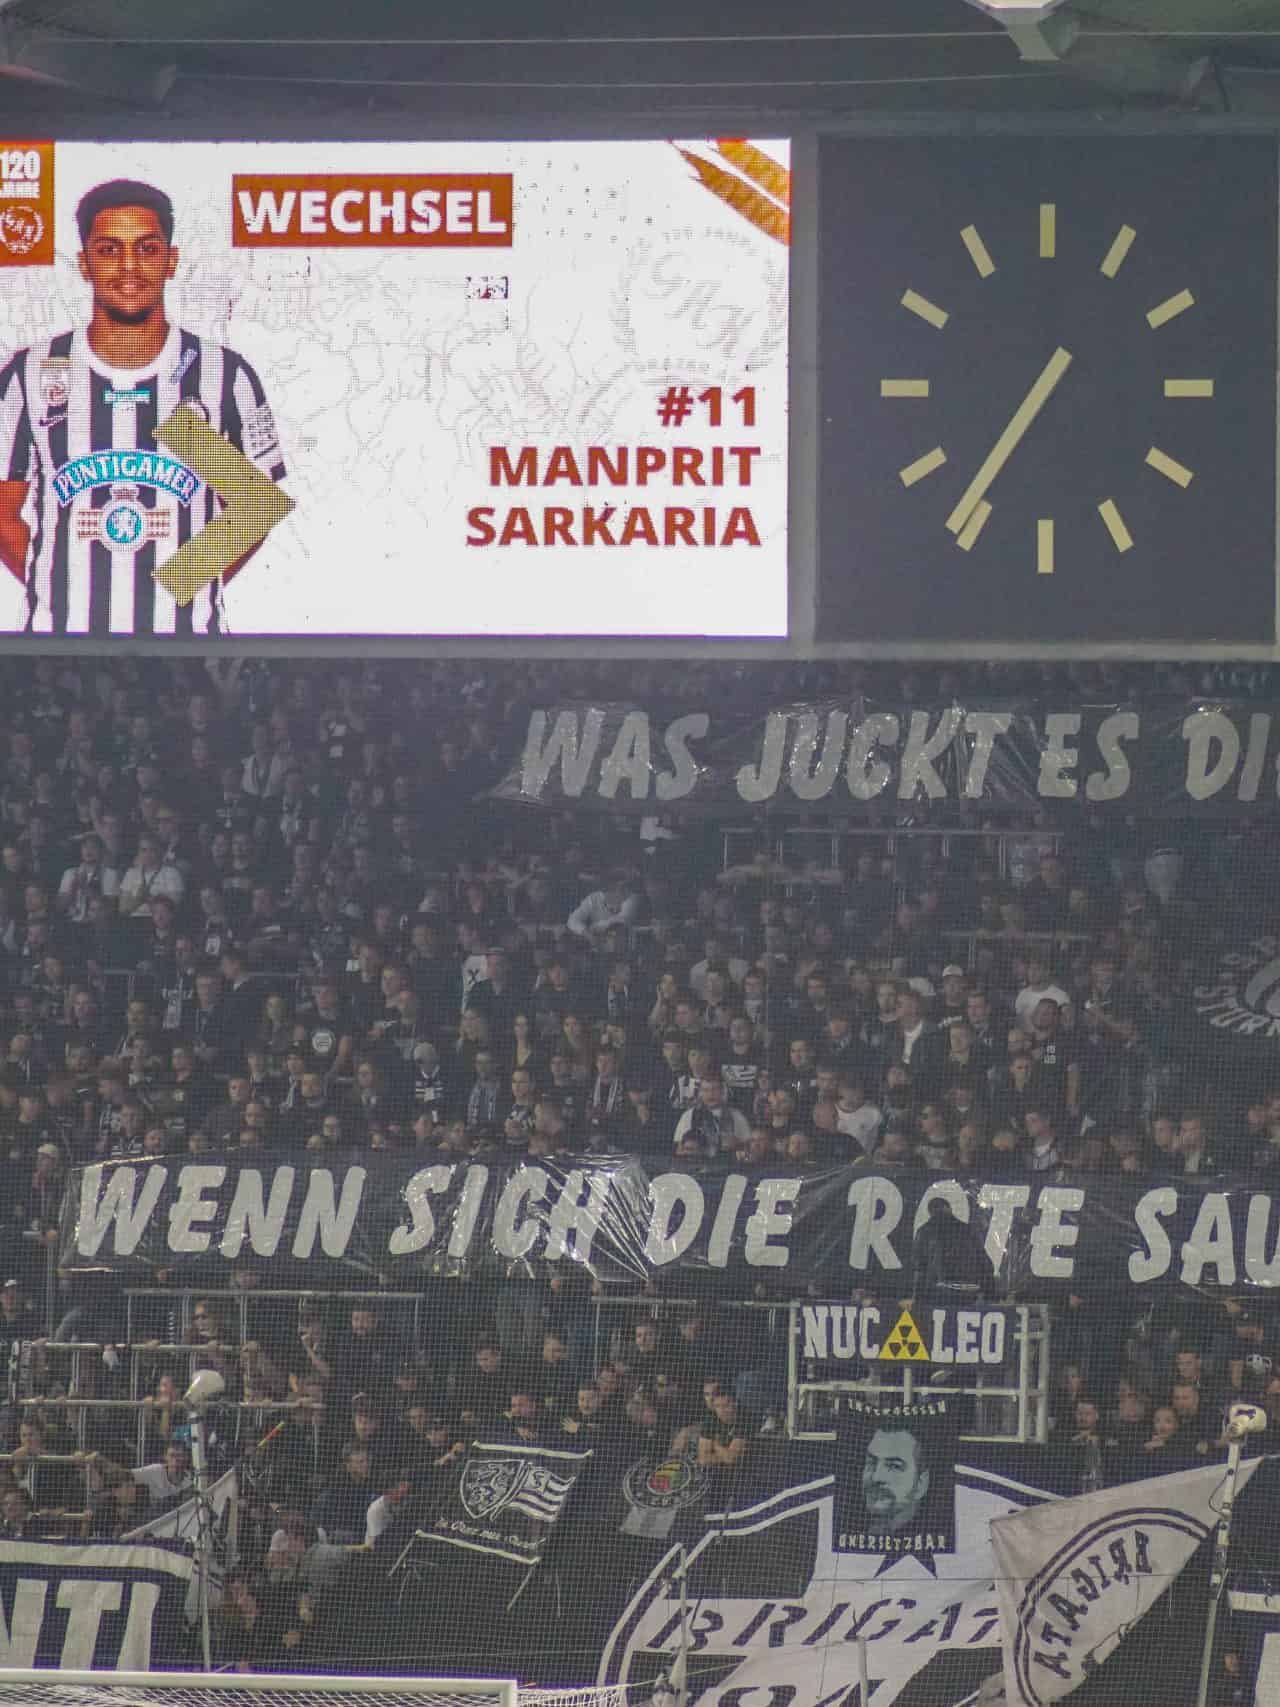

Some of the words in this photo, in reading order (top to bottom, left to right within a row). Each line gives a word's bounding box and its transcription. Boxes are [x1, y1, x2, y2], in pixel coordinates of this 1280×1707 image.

[0, 150, 41, 179] 120
[238, 190, 507, 234] WECHSEL
[657, 386, 758, 427] #11
[56, 454, 197, 501] PUNTIGAMER
[488, 446, 762, 487] MANPRIT
[465, 505, 762, 547] SARKARIA
[519, 706, 709, 800] WAS
[736, 708, 1012, 802] JUCKT
[1037, 711, 1140, 801] ES
[75, 1165, 366, 1258] WENN
[388, 1162, 602, 1261] SICH
[643, 1173, 802, 1267] DIE
